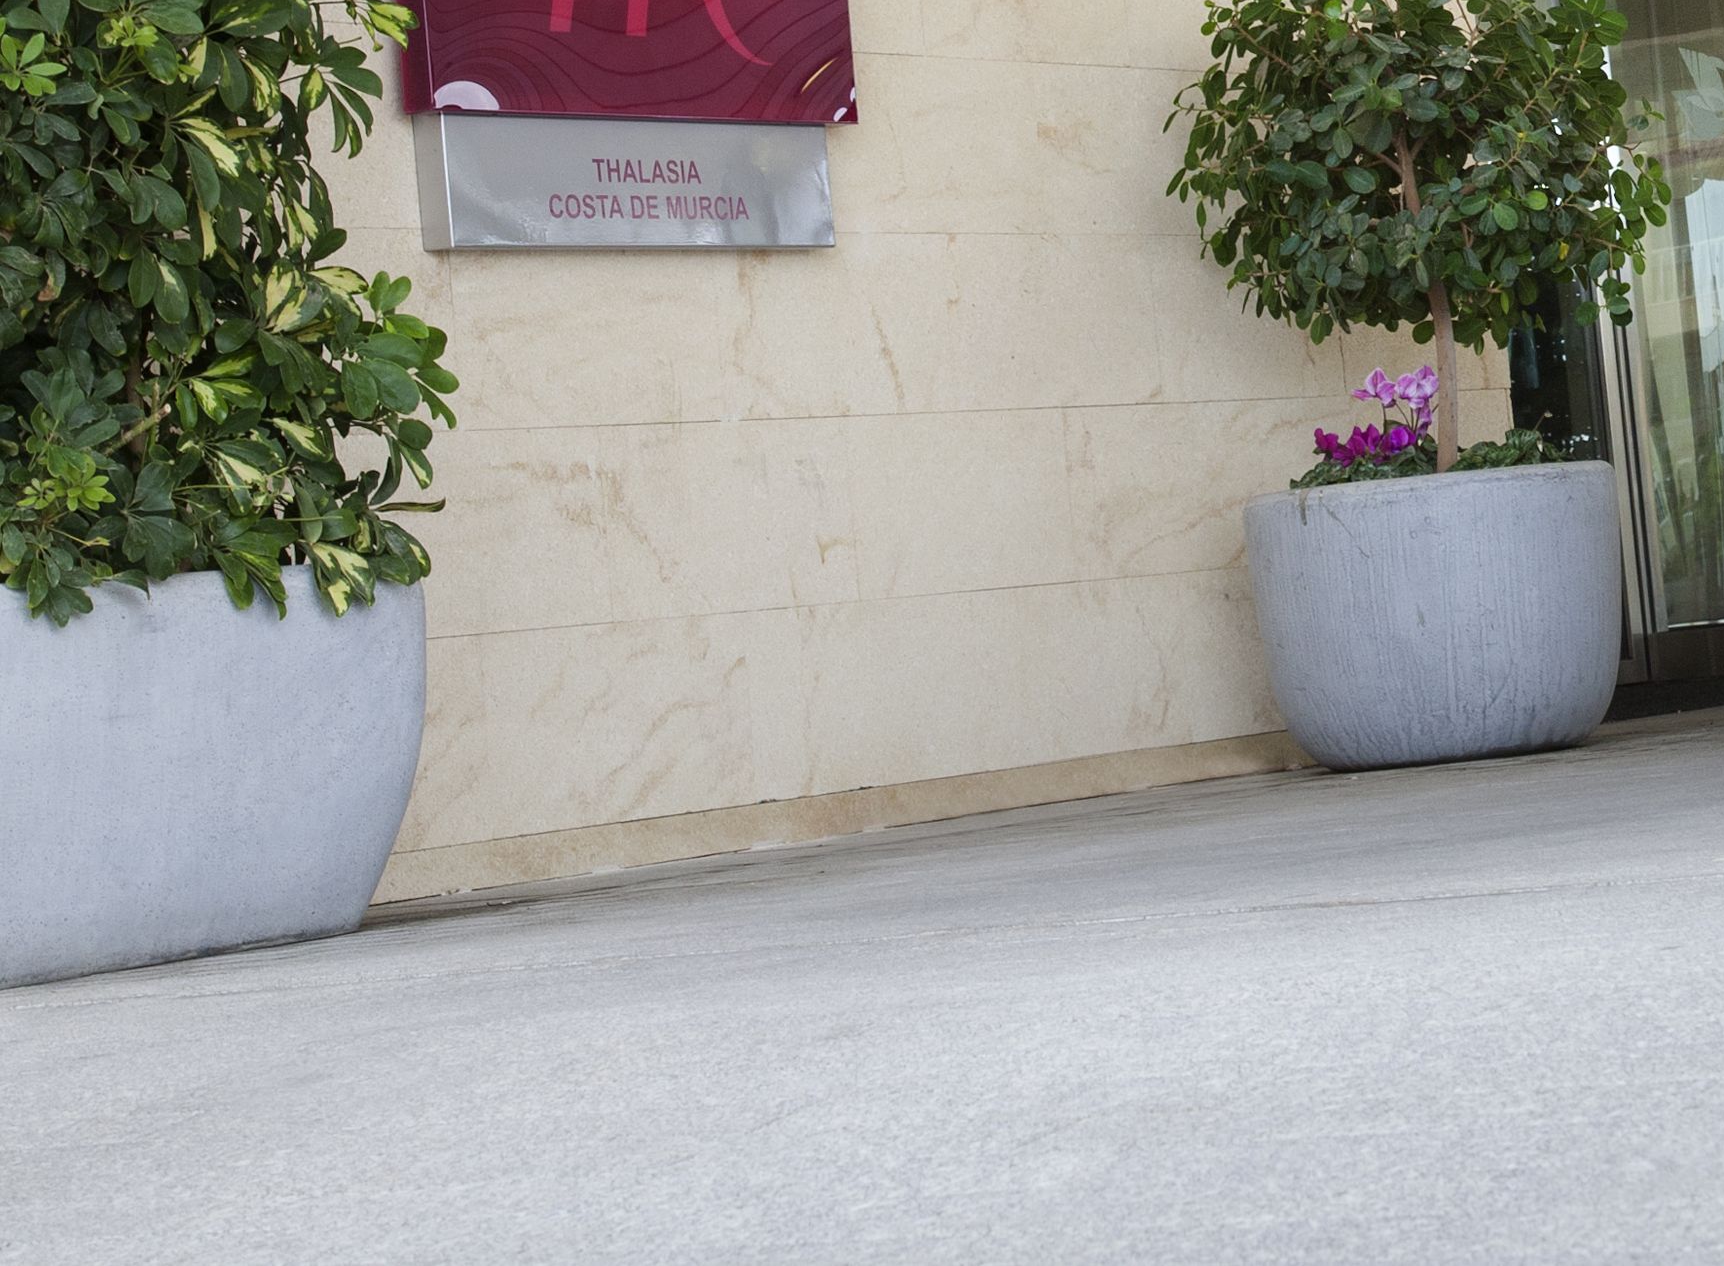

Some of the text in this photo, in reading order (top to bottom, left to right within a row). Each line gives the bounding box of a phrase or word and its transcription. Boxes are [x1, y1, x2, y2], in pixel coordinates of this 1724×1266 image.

[592, 158, 702, 184] THALASIA
[549, 193, 749, 221] COSTA DE MURCIA
